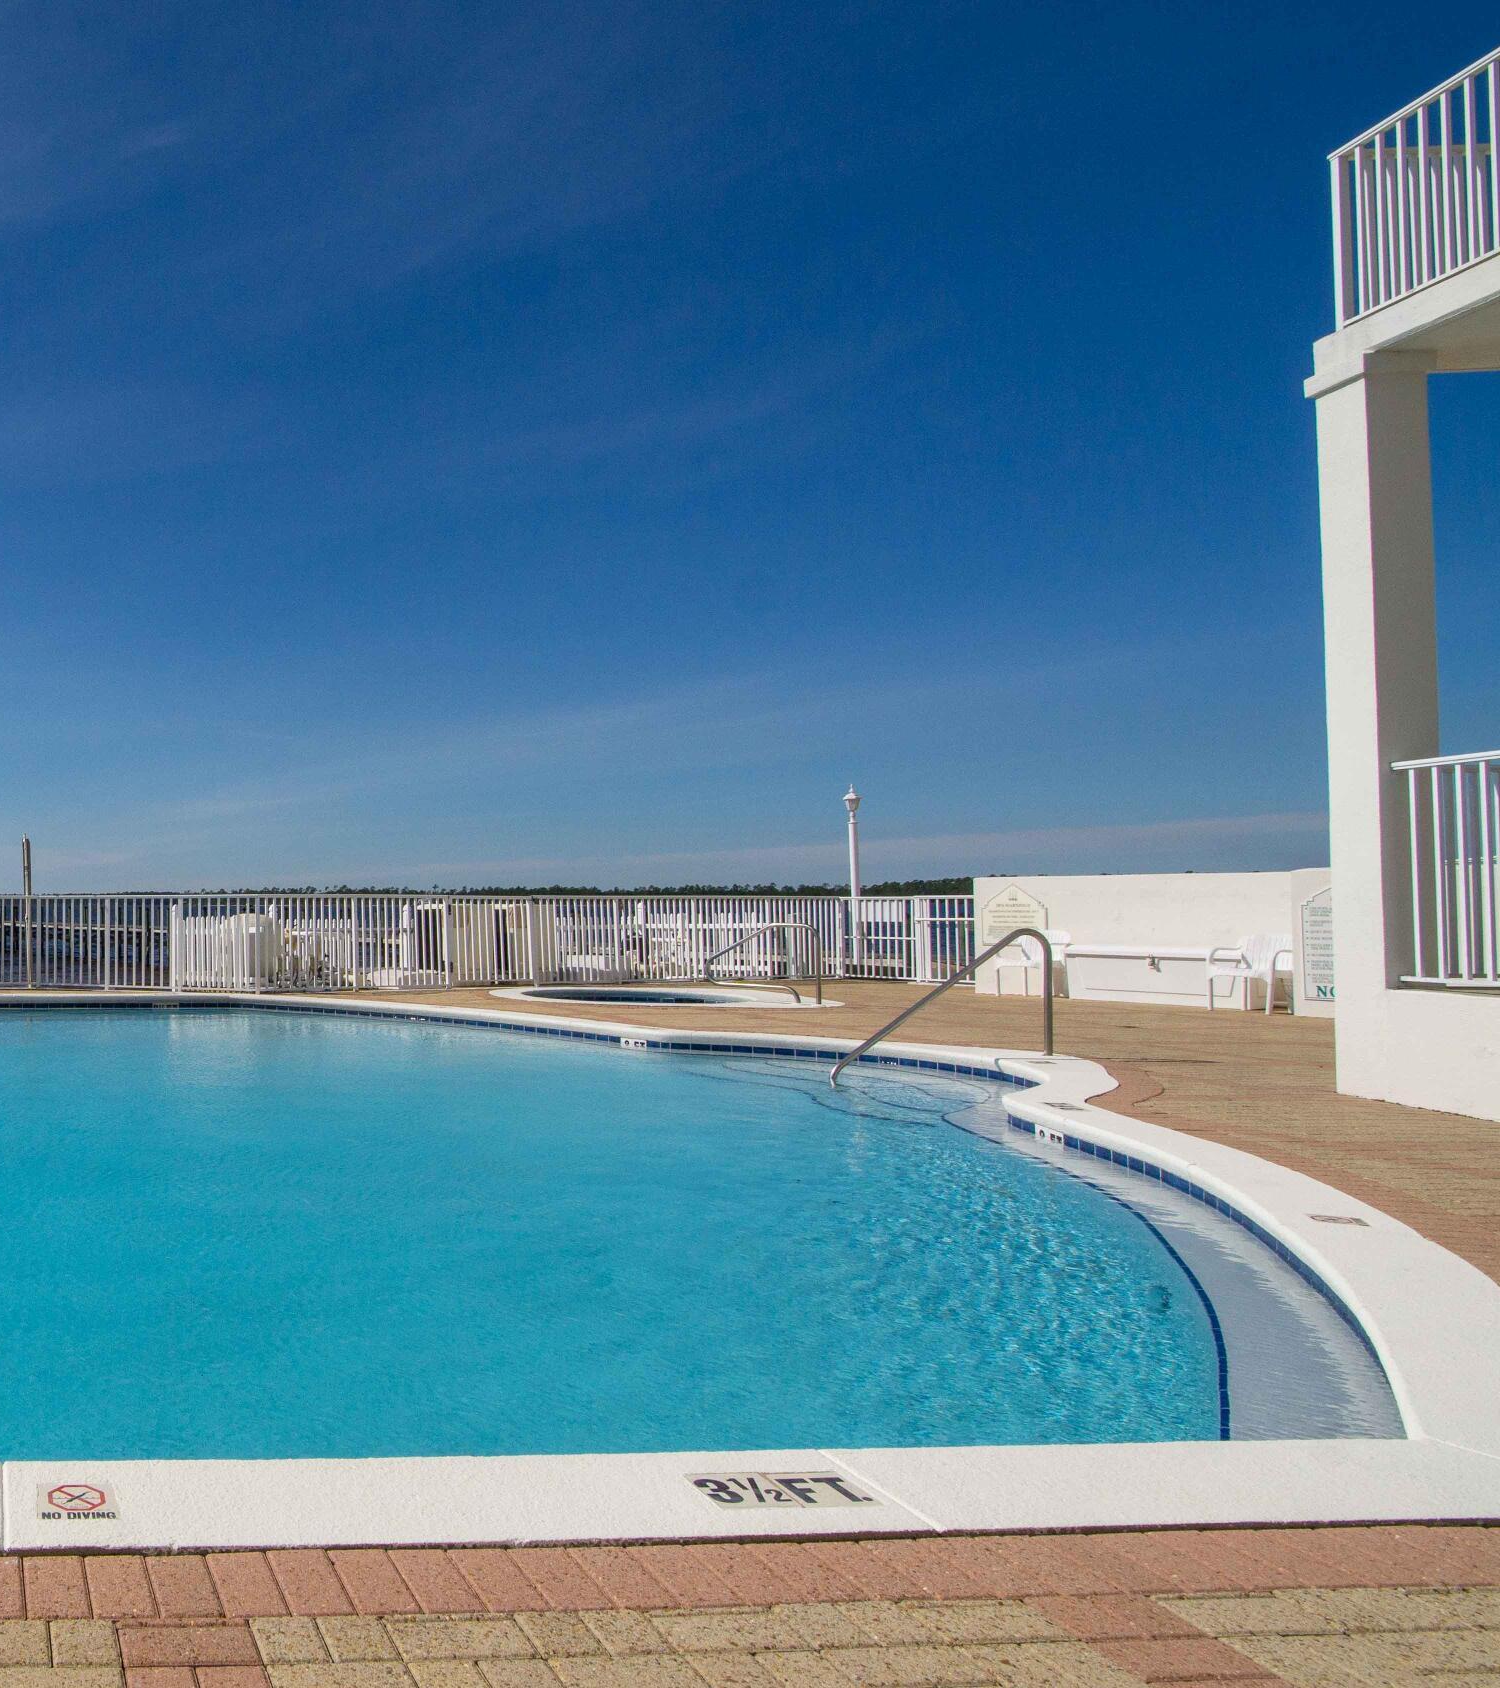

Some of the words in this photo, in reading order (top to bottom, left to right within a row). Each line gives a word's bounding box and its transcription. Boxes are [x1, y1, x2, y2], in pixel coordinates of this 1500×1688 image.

[774, 1476, 874, 1504] FT.
[41, 1511, 62, 1520] NO
[67, 1511, 117, 1520] DIVING
